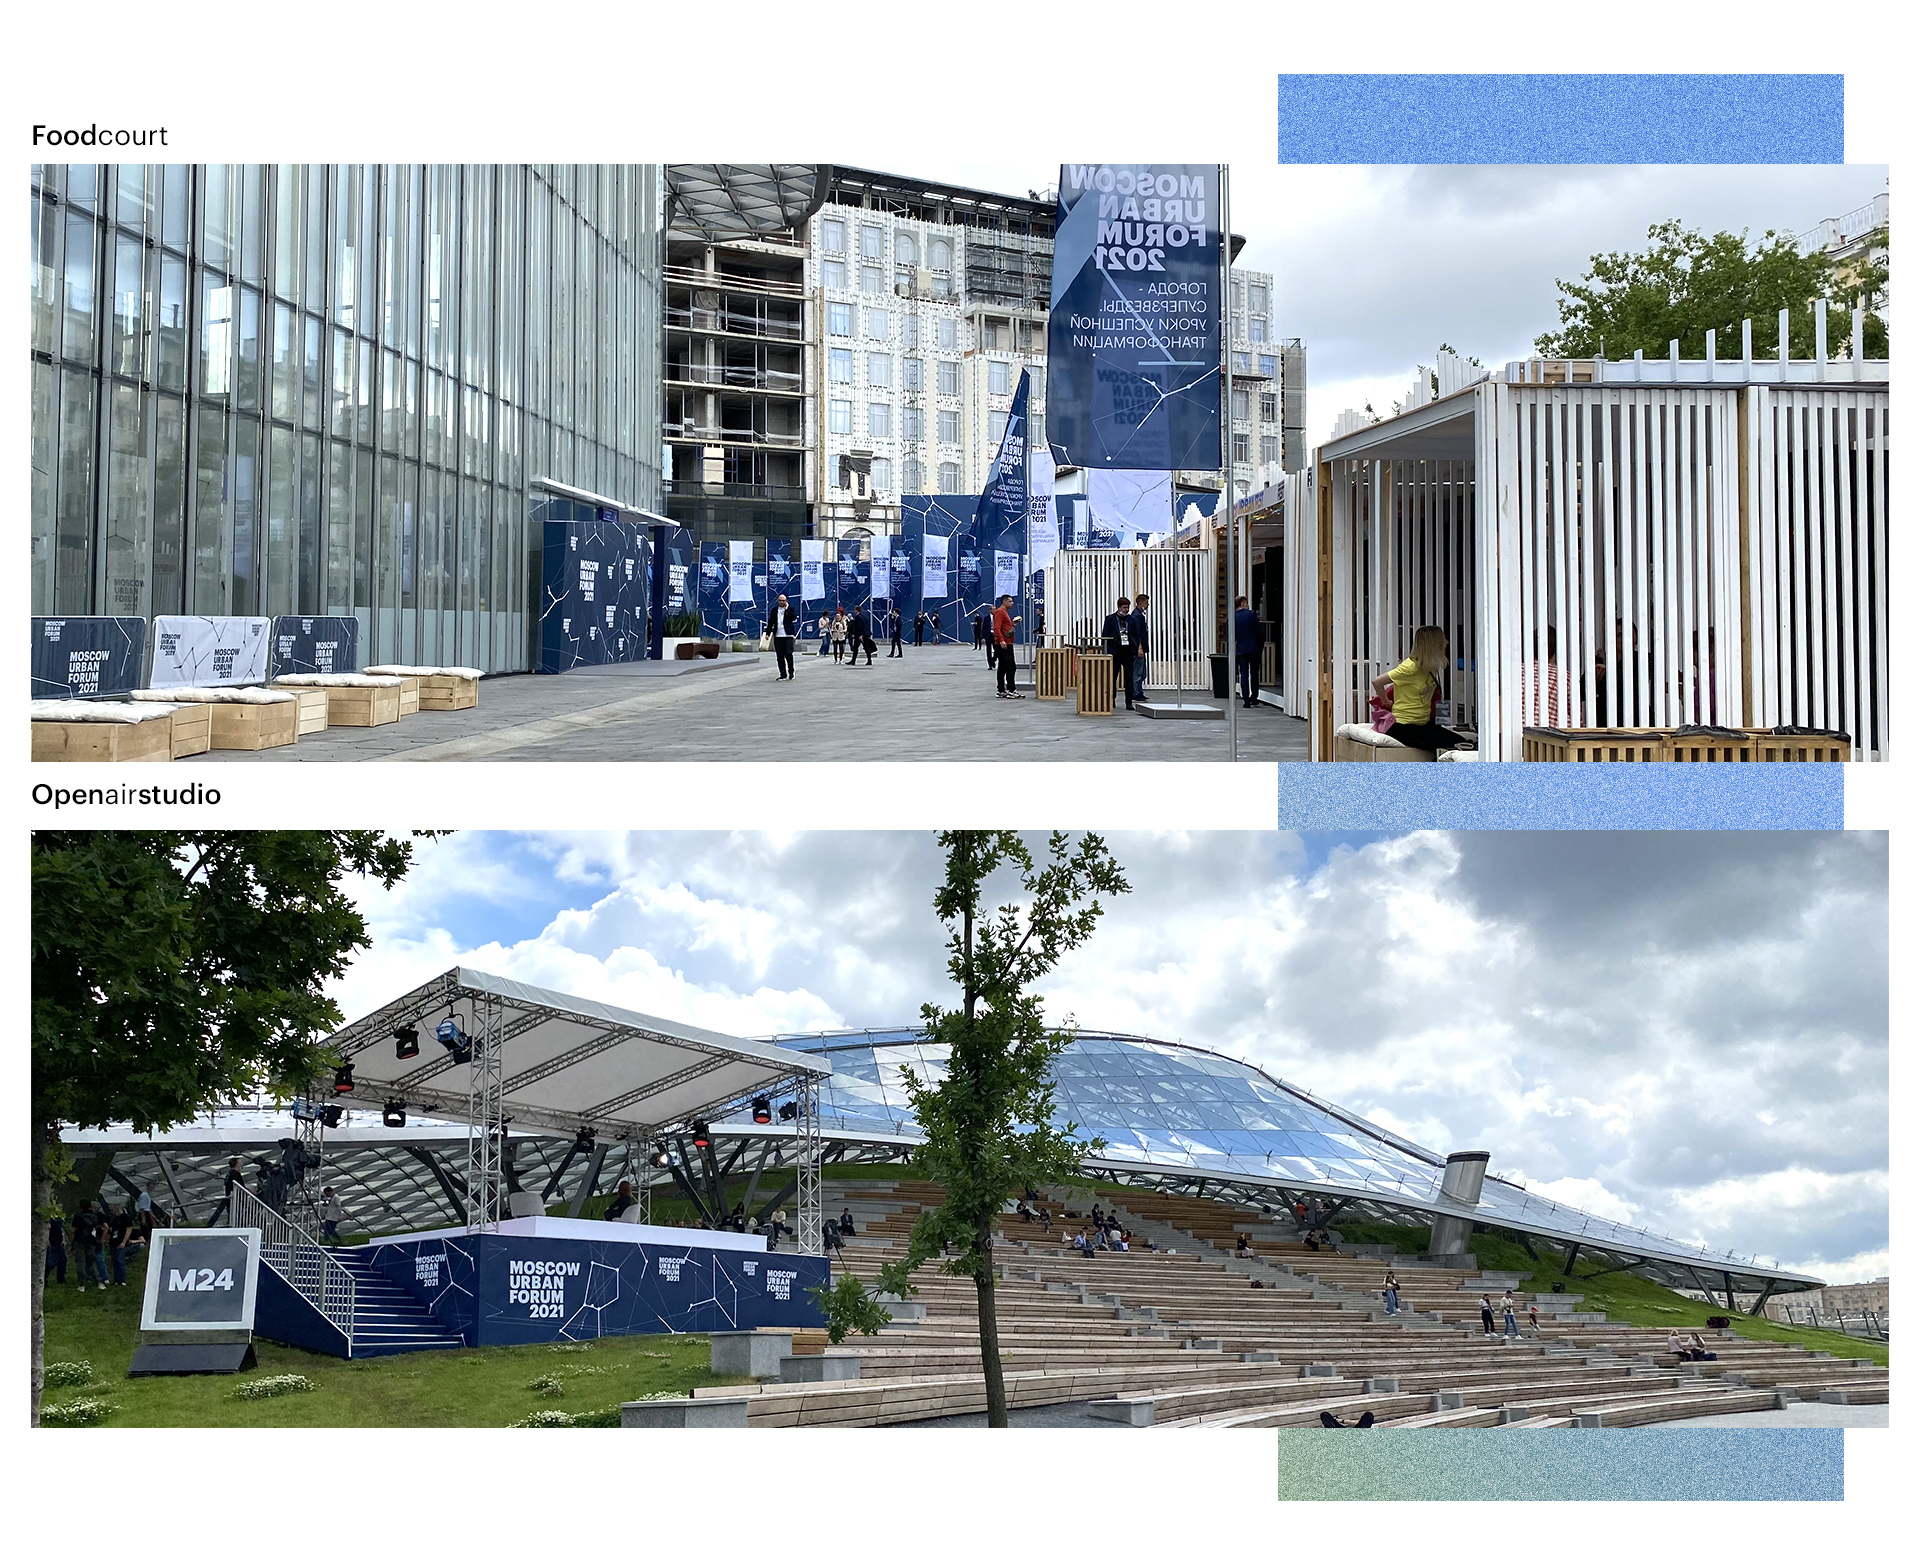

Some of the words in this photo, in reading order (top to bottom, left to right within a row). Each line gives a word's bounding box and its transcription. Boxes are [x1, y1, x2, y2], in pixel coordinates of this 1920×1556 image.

[70, 651, 110, 661] MOSCOW
[214, 648, 240, 656] MOSCOW
[69, 661, 99, 672] URBAN
[68, 672, 98, 683] FORUM
[78, 683, 98, 693] 2021
[415, 1254, 446, 1264] MOSCOW
[416, 1263, 439, 1272] URBAN
[509, 1260, 581, 1276] MOSCOW
[416, 1270, 439, 1280] FORUM
[767, 1269, 797, 1279] MOSCOW
[168, 1268, 234, 1291] M24
[423, 1279, 439, 1287] 2021
[509, 1275, 564, 1289] URBAN
[767, 1277, 790, 1285] URBAN
[767, 1284, 790, 1293] FORUM
[509, 1289, 564, 1304] FORUM
[774, 1292, 790, 1300] 2021
[529, 1304, 564, 1318] 2021
